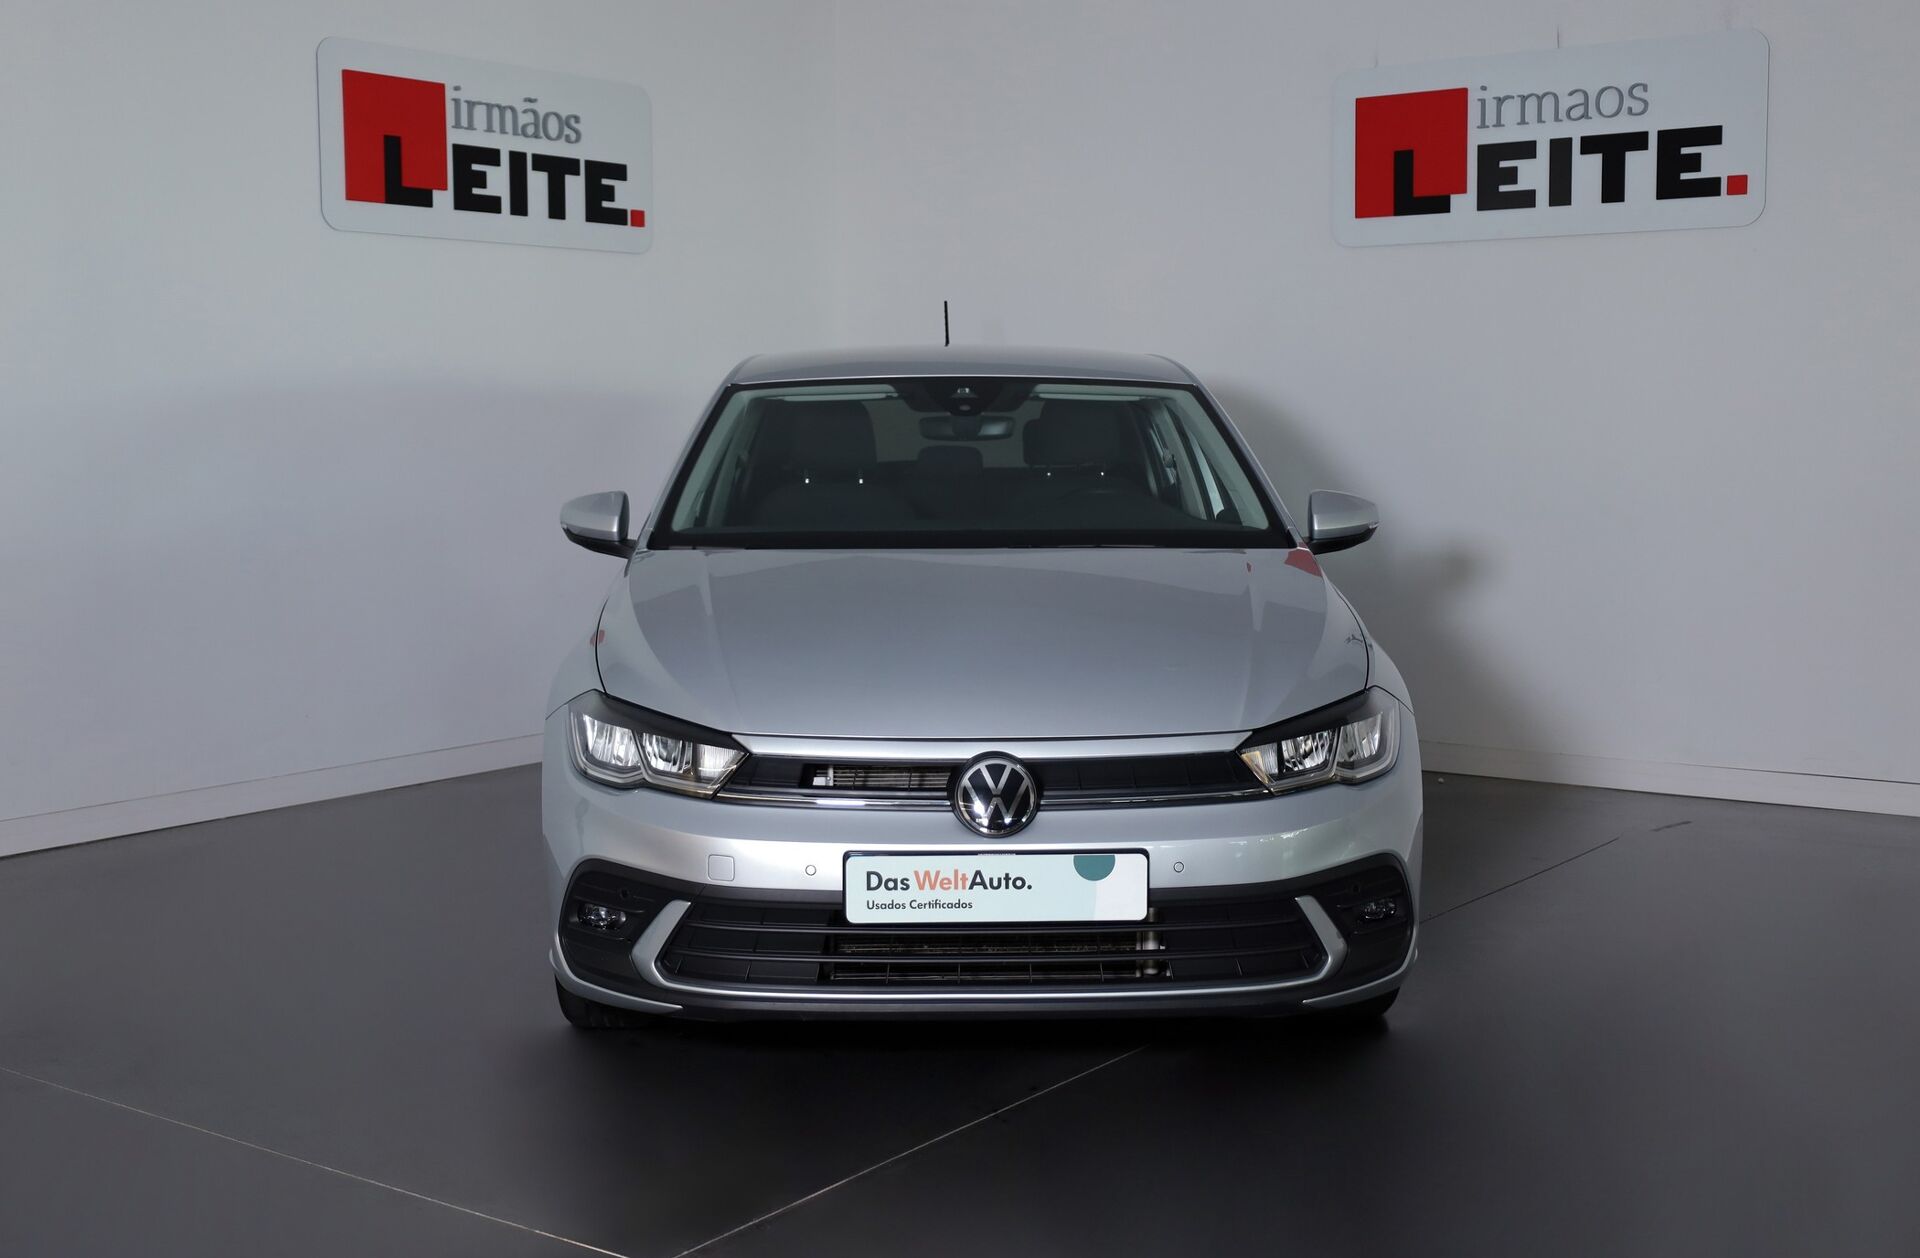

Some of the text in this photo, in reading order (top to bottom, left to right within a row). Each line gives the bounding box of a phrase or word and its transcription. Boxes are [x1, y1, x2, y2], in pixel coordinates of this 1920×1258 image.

[451, 85, 582, 144] irmãos
[1476, 82, 1650, 129] irmaos
[866, 870, 910, 891] Das
[866, 899, 973, 911] Usados Certificados
